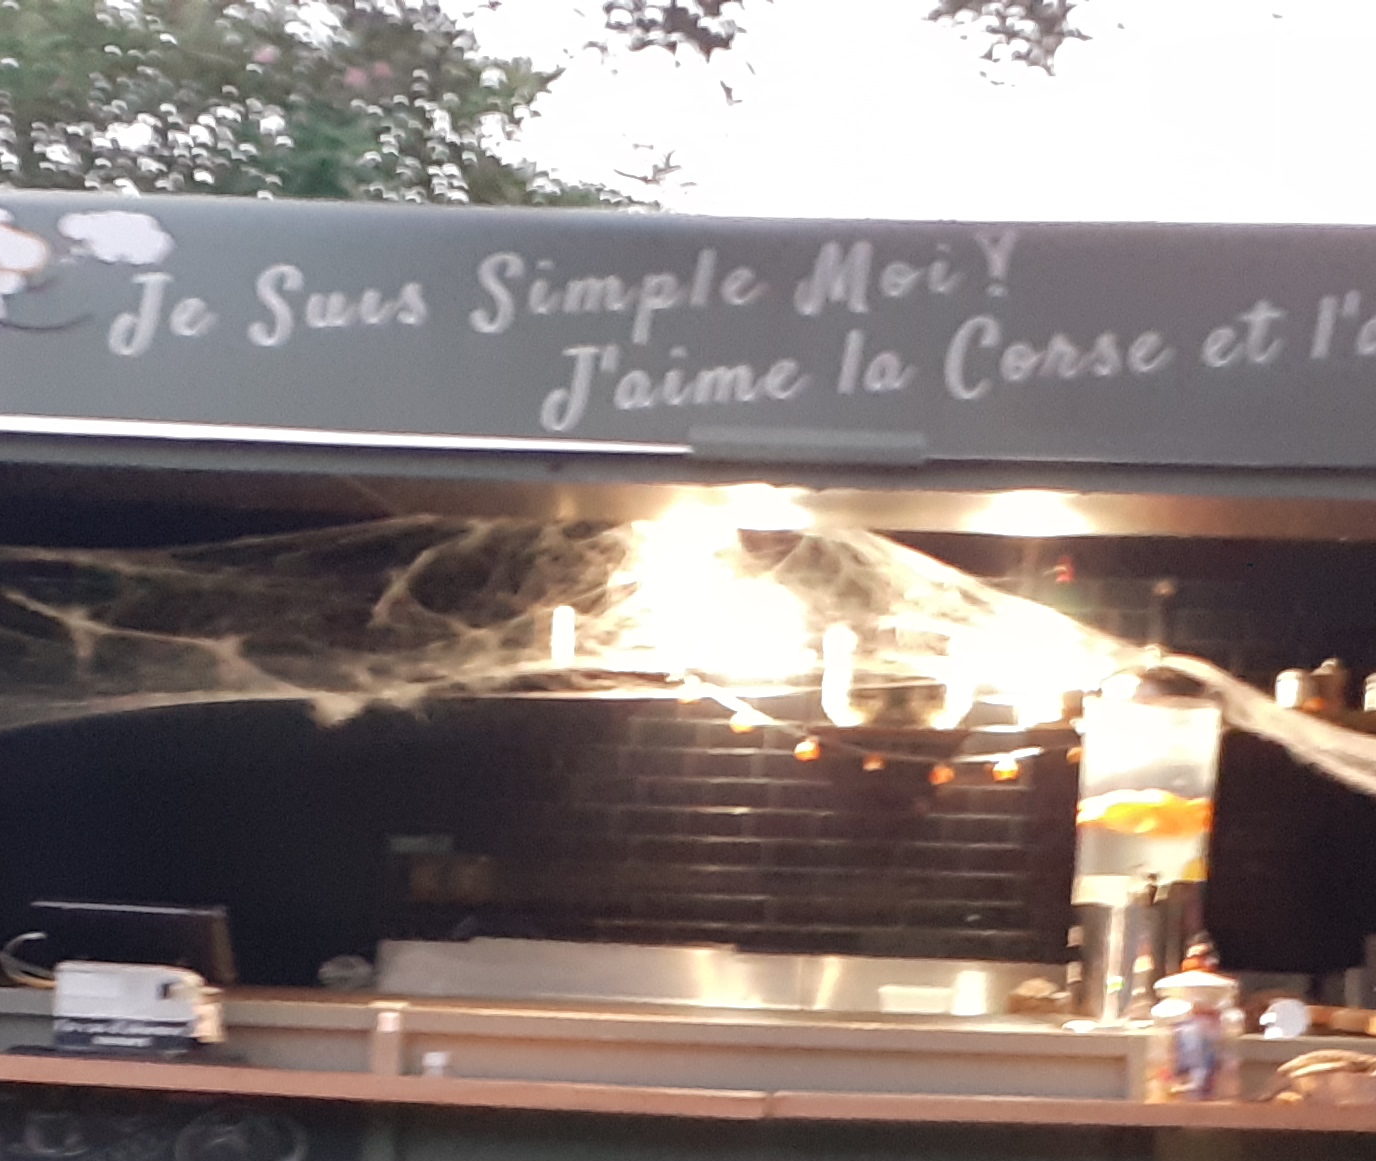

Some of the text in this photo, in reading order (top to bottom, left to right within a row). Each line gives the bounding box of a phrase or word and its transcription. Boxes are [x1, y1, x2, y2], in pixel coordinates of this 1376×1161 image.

[109, 271, 218, 356] Je
[469, 249, 769, 344] Simple
[539, 344, 810, 432] J'aime
[836, 329, 916, 394] la
[944, 315, 1170, 400] Corse
[1201, 300, 1286, 367] et
